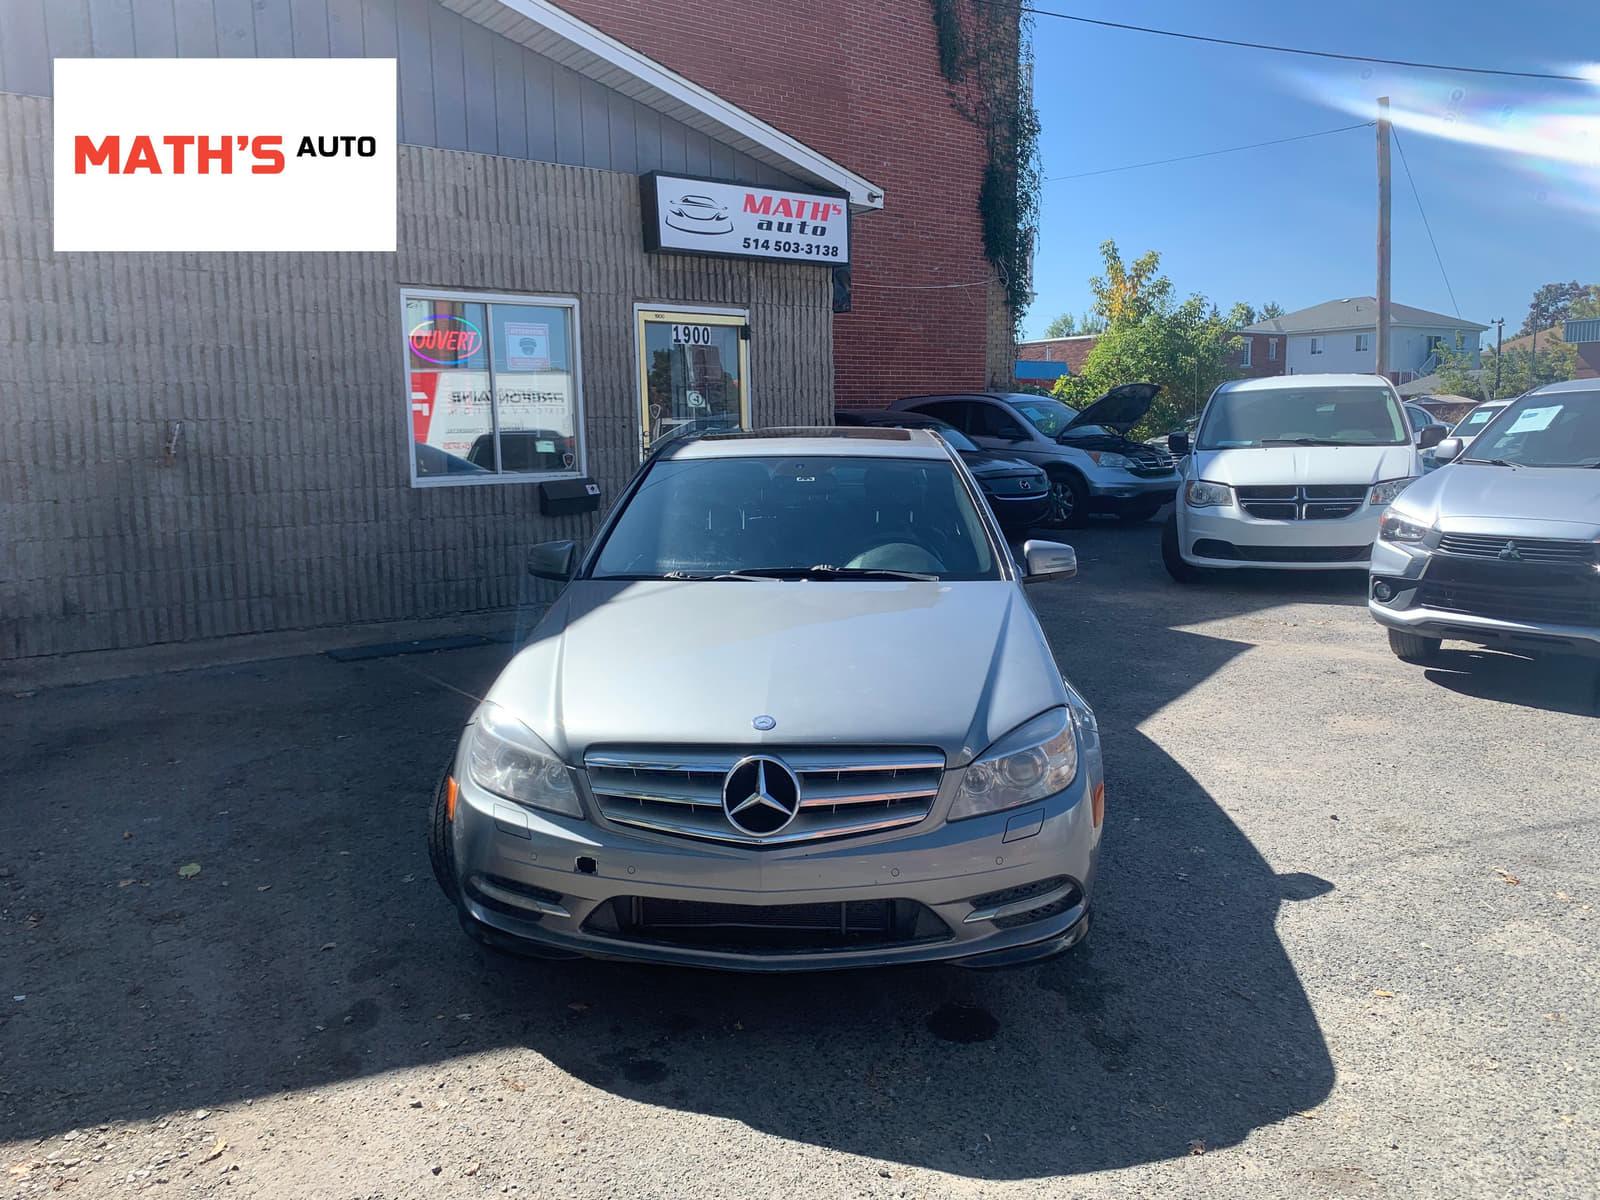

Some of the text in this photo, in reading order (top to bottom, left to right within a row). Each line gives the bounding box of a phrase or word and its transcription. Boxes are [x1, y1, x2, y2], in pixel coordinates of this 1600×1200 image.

[757, 219, 827, 236] auto
[742, 237, 839, 257] 514 503-3138
[413, 330, 477, 351] OUVERT
[673, 326, 710, 344] 1900
